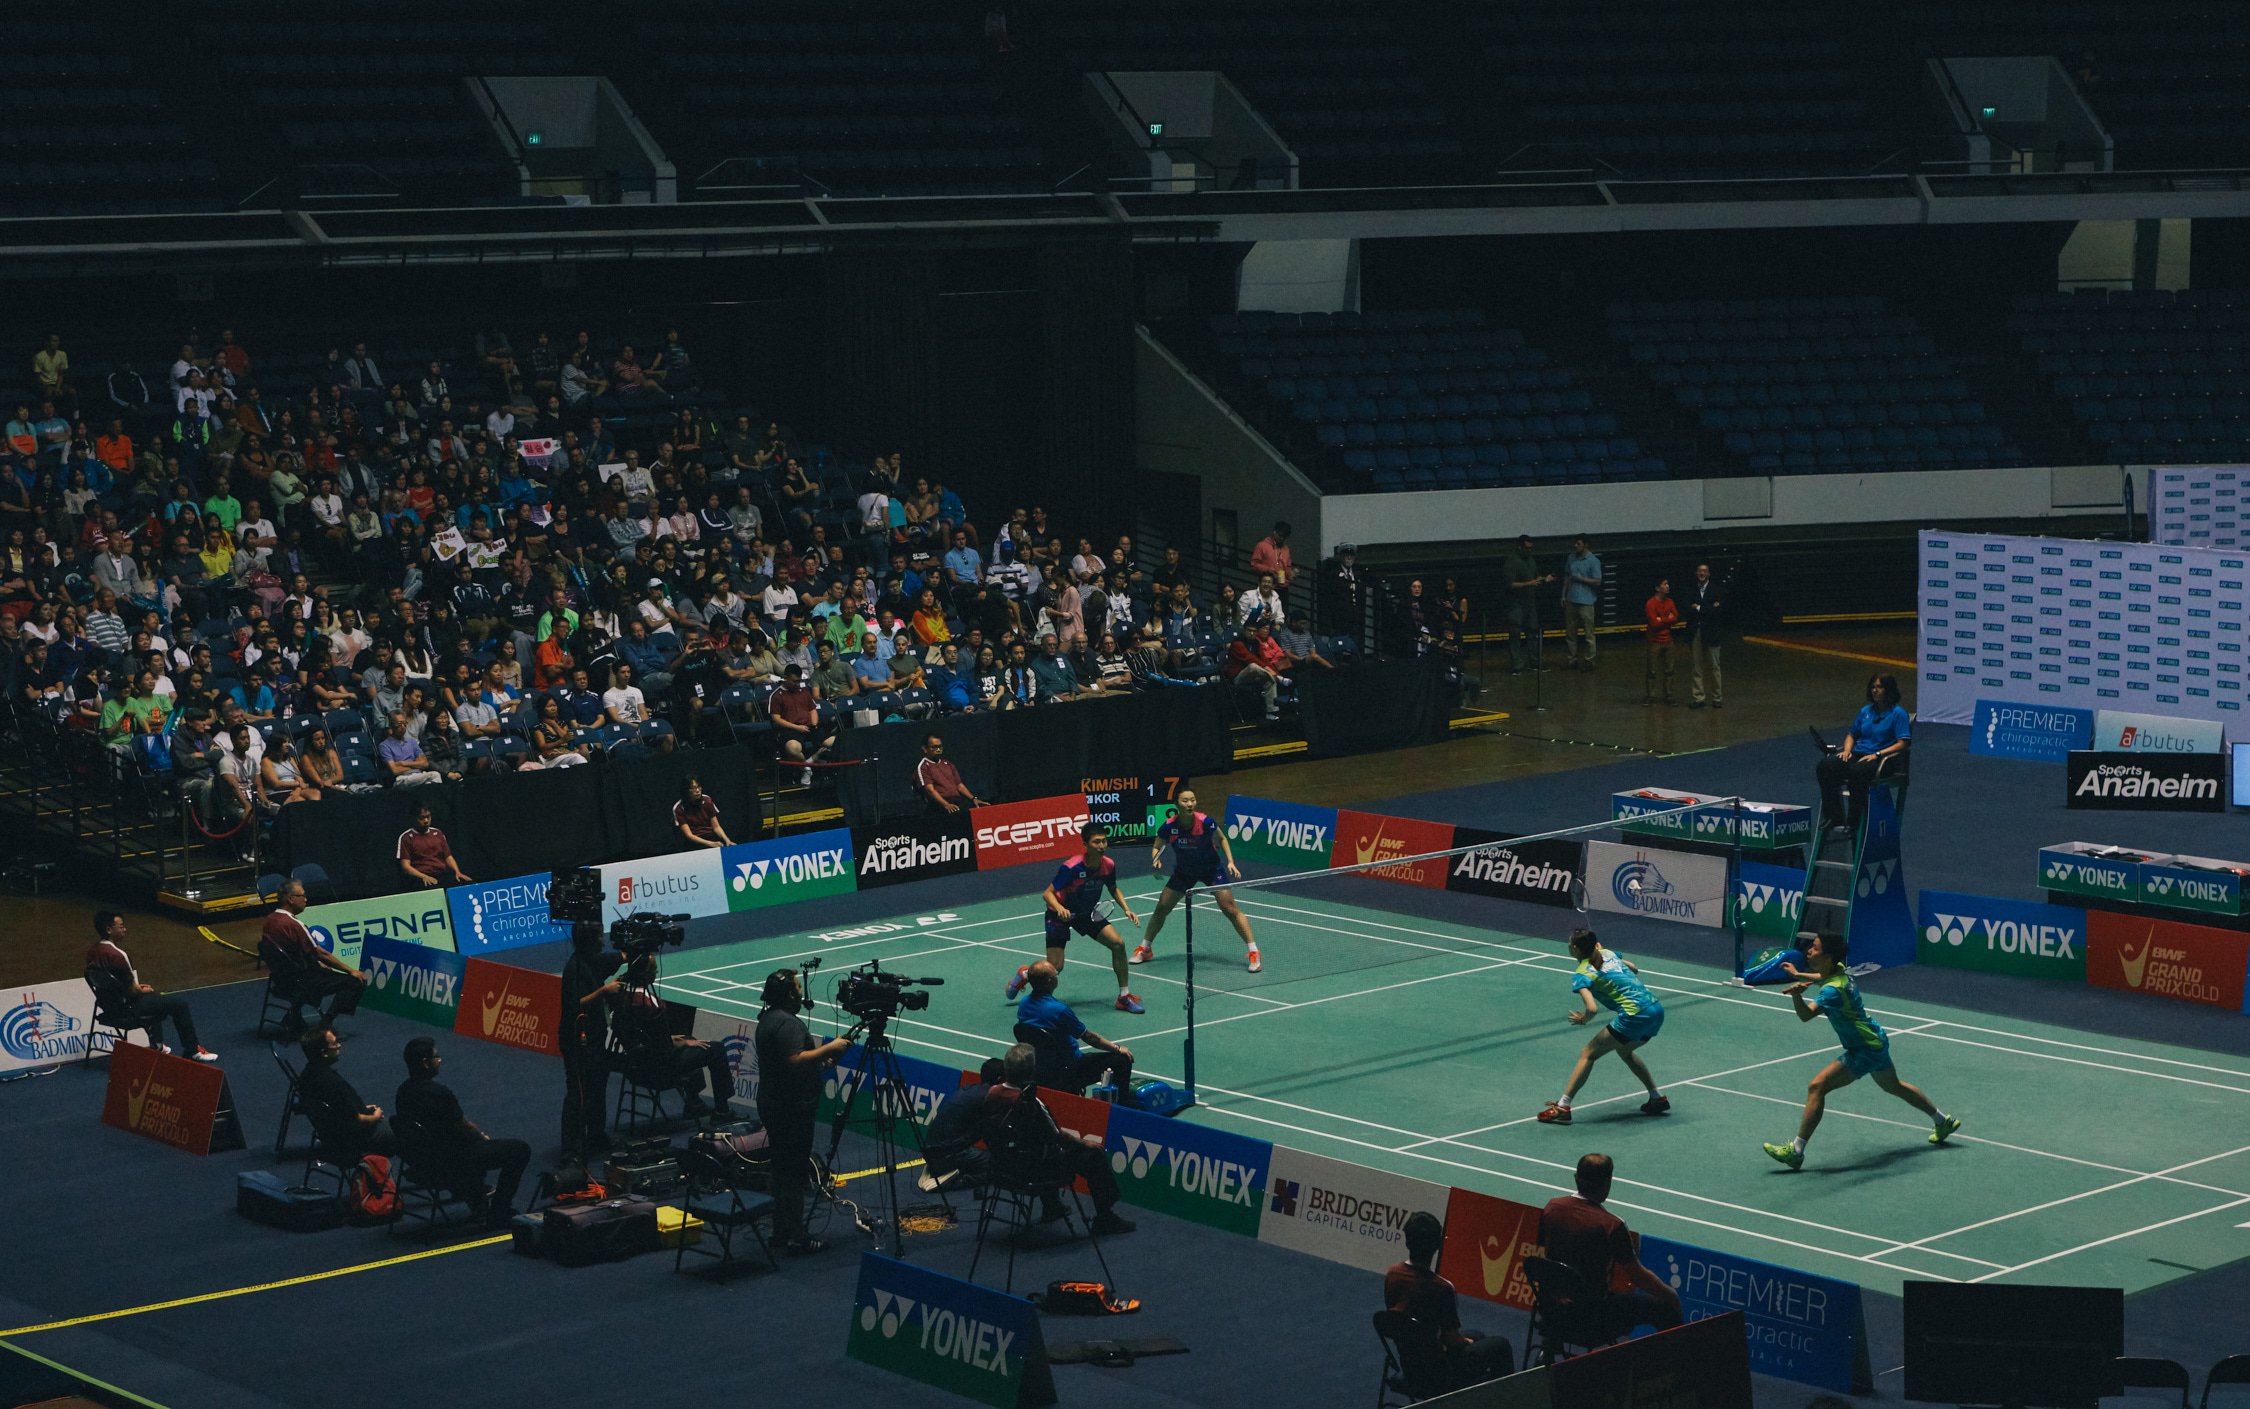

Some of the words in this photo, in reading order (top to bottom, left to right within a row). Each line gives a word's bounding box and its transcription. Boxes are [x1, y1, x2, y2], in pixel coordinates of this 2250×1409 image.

[1150, 124, 1163, 135] EXIT
[2000, 709, 2077, 733] PREMIER
[2001, 731, 2069, 748] chiropractic
[2122, 729, 2195, 752] arbutus
[2098, 764, 2143, 777] Sports
[1081, 776, 1139, 792] KIM/SHI
[1147, 783, 1154, 797] 1
[1163, 776, 1180, 800] 7
[2075, 770, 2218, 799] Anaheim
[1094, 793, 1120, 804] KOR
[1094, 812, 1120, 823] KOR
[1788, 819, 1810, 832] YONEX
[875, 835, 911, 850] Sports
[977, 814, 1089, 849] SCEPTRE
[1267, 818, 1327, 852] YONEX
[860, 836, 970, 876] Anaheim
[1379, 838, 1406, 850] BWF
[774, 848, 846, 885] YONEX
[1453, 850, 1572, 893] Anaheim
[2077, 865, 2127, 890] YONEX
[621, 875, 699, 901] arbutus
[2178, 879, 2229, 904] YONEX
[1631, 895, 1696, 919] BADMINTON
[493, 912, 550, 932] chiropra
[808, 922, 915, 942] YONEX
[1982, 918, 2075, 960] YONEX
[2152, 946, 2187, 961] BWF
[2148, 961, 2202, 983] GRAND
[400, 963, 457, 1007] YONEX
[505, 994, 531, 1009] BWF
[501, 1009, 539, 1031] GRAND
[32, 1029, 115, 1060] BADMINTON
[150, 1083, 174, 1099] BWF
[144, 1099, 181, 1124] GRAND
[1168, 1147, 1256, 1208] YONEX
[1309, 1187, 1408, 1230] BRIDGEW
[1306, 1210, 1354, 1232] CAPITAL
[1360, 1224, 1402, 1244] GROUP
[1686, 1259, 1827, 1325] PREMIER
[920, 1303, 1015, 1377] YONEX
